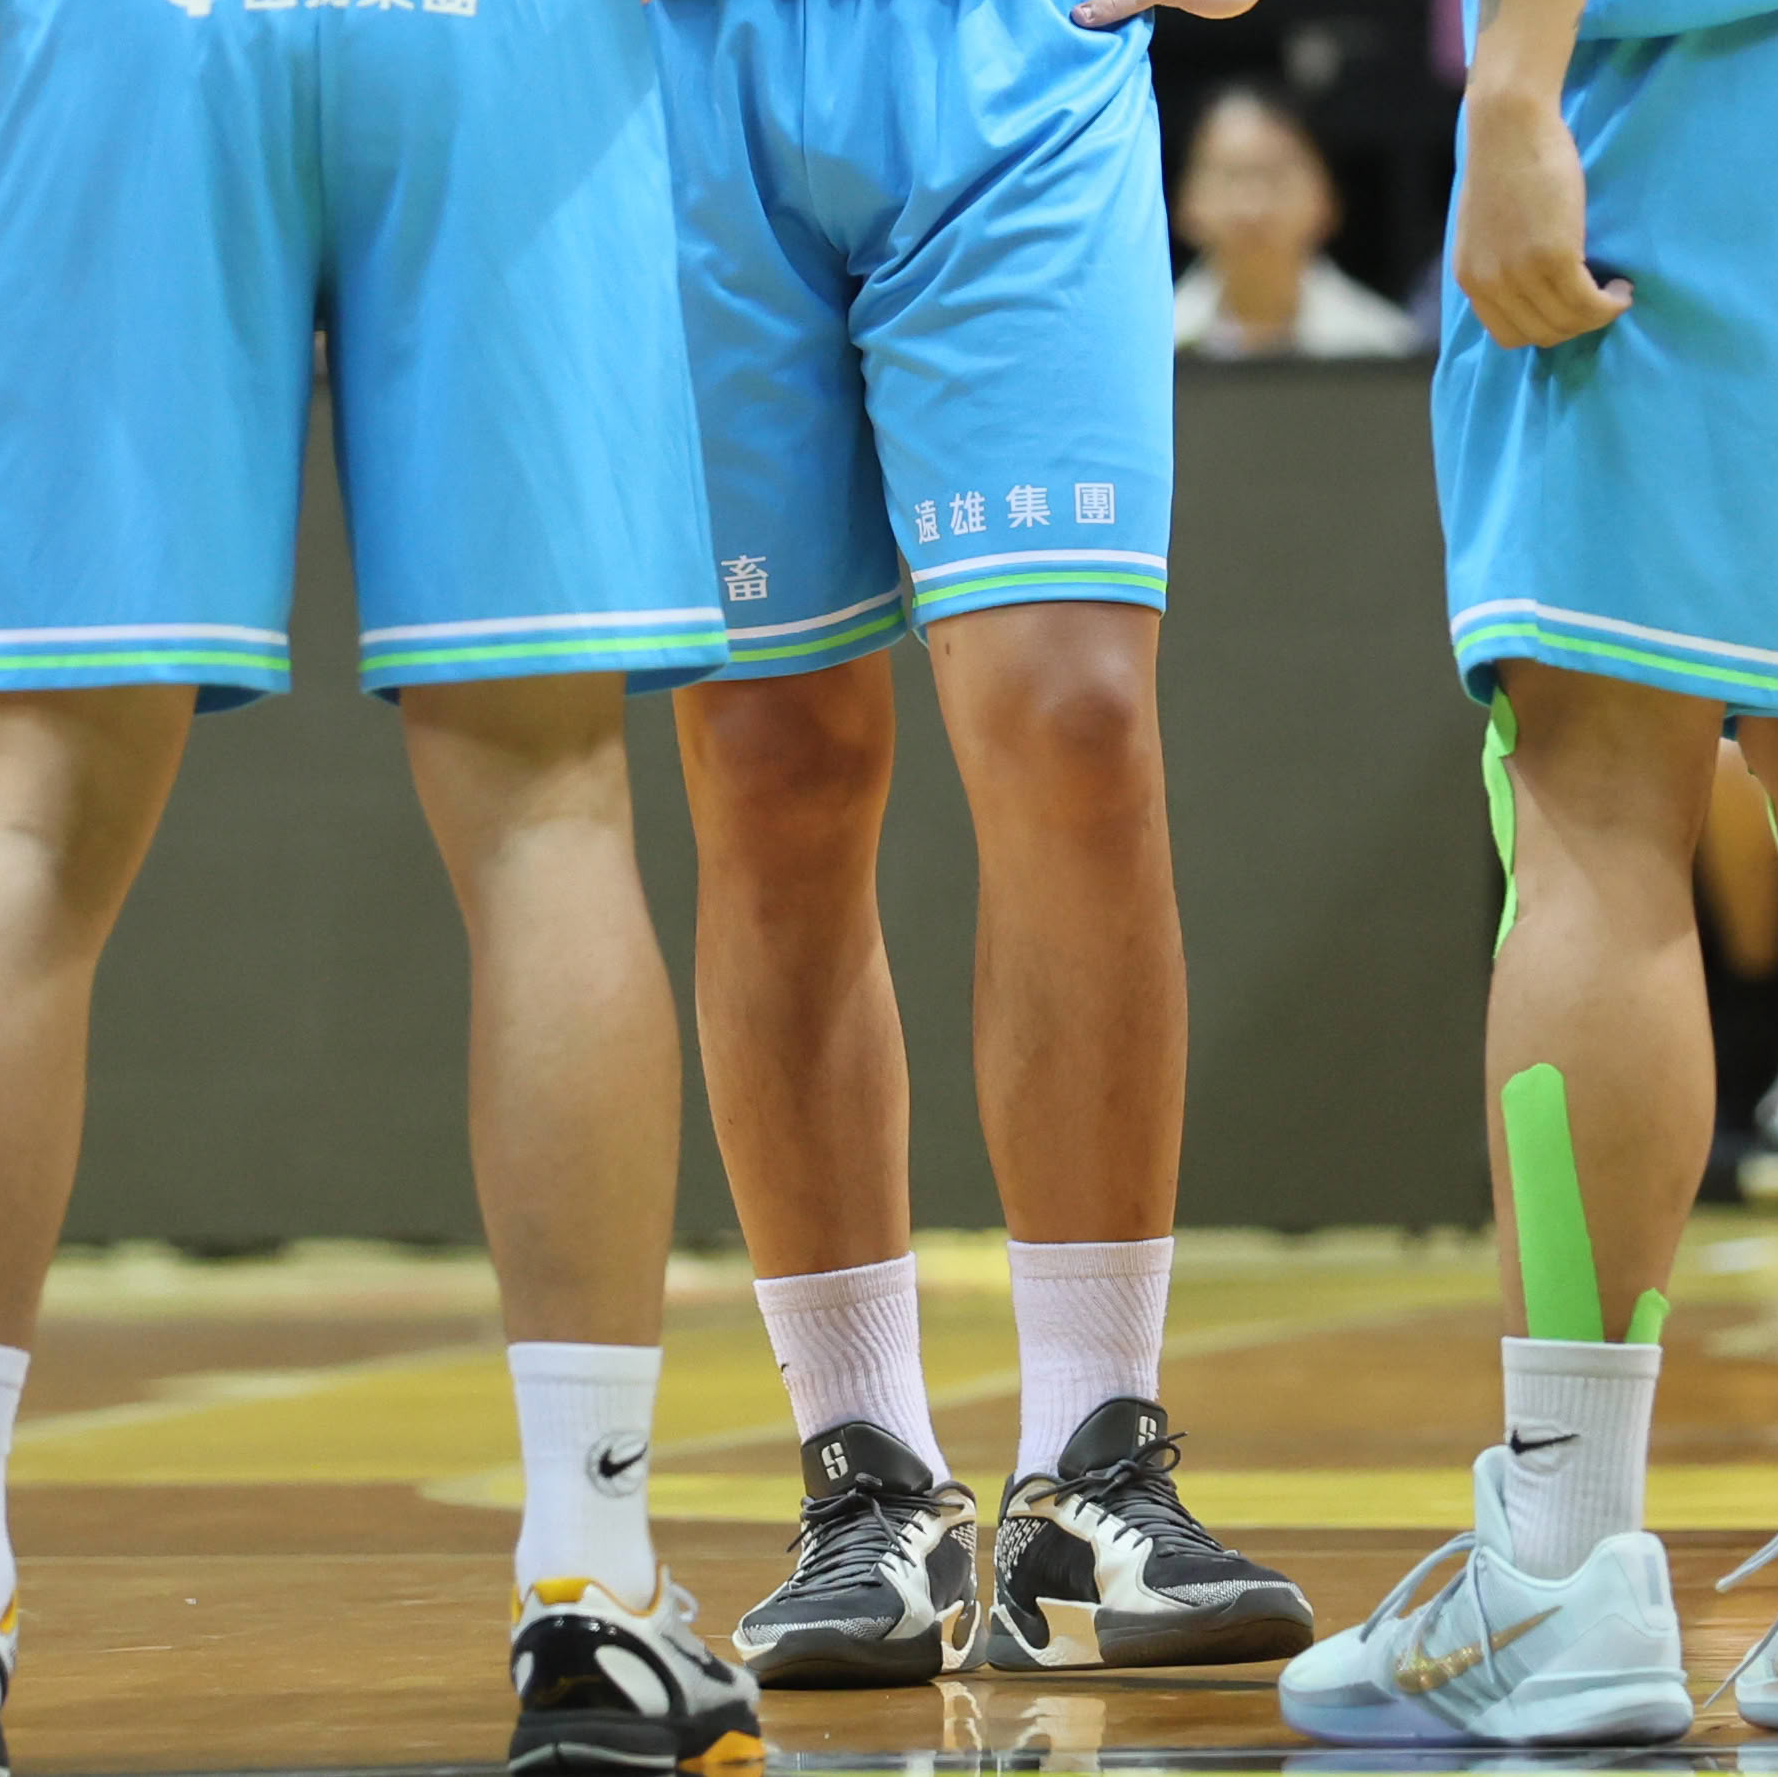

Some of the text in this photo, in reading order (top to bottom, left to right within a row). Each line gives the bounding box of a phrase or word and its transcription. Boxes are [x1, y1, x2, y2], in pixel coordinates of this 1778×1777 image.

[913, 482, 1116, 545] 遠雄集團
[720, 554, 770, 602] 畜
